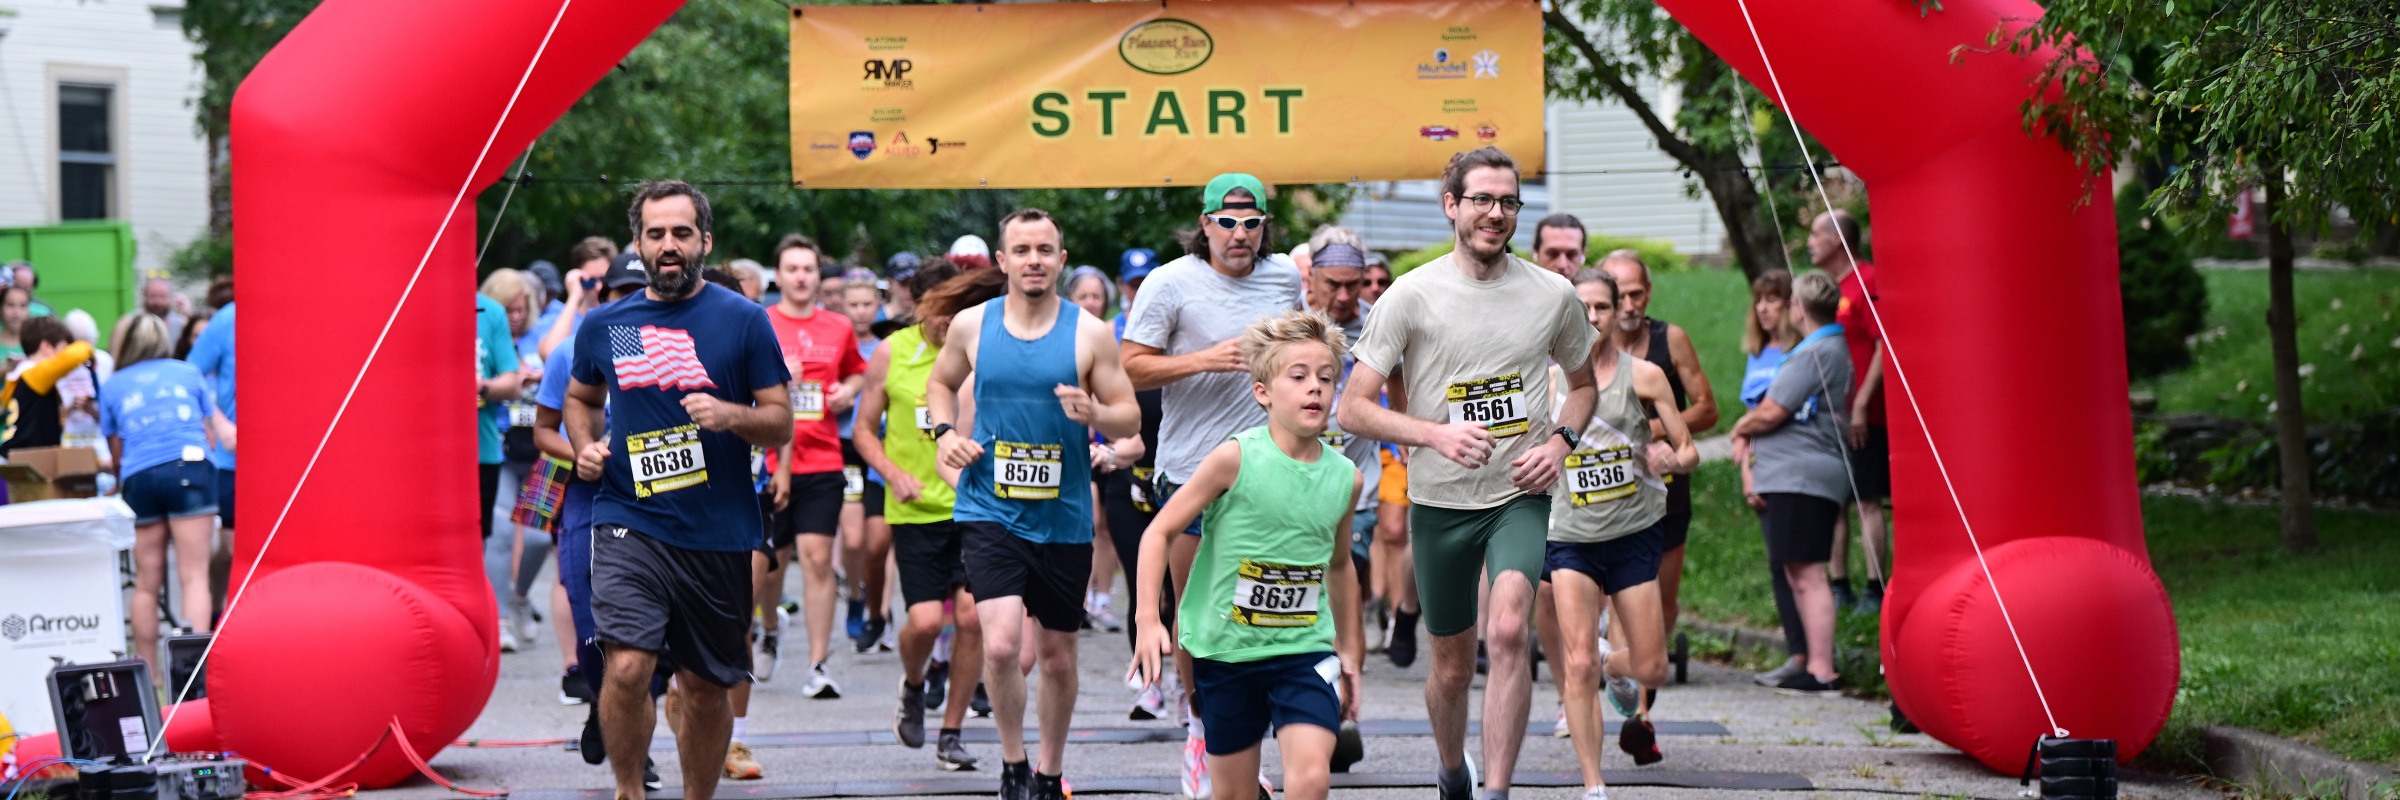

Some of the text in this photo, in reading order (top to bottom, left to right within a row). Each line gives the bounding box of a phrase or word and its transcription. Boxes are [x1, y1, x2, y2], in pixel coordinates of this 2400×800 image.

[1128, 33, 1206, 50] Pleasant Run
[1031, 89, 1303, 137] START
[1462, 396, 1514, 421] 8561
[640, 448, 694, 476] 8638
[1005, 462, 1049, 483] 8576
[1577, 465, 1625, 488] 8536
[1249, 584, 1307, 609] 8637
[30, 613, 99, 633] Arrow
